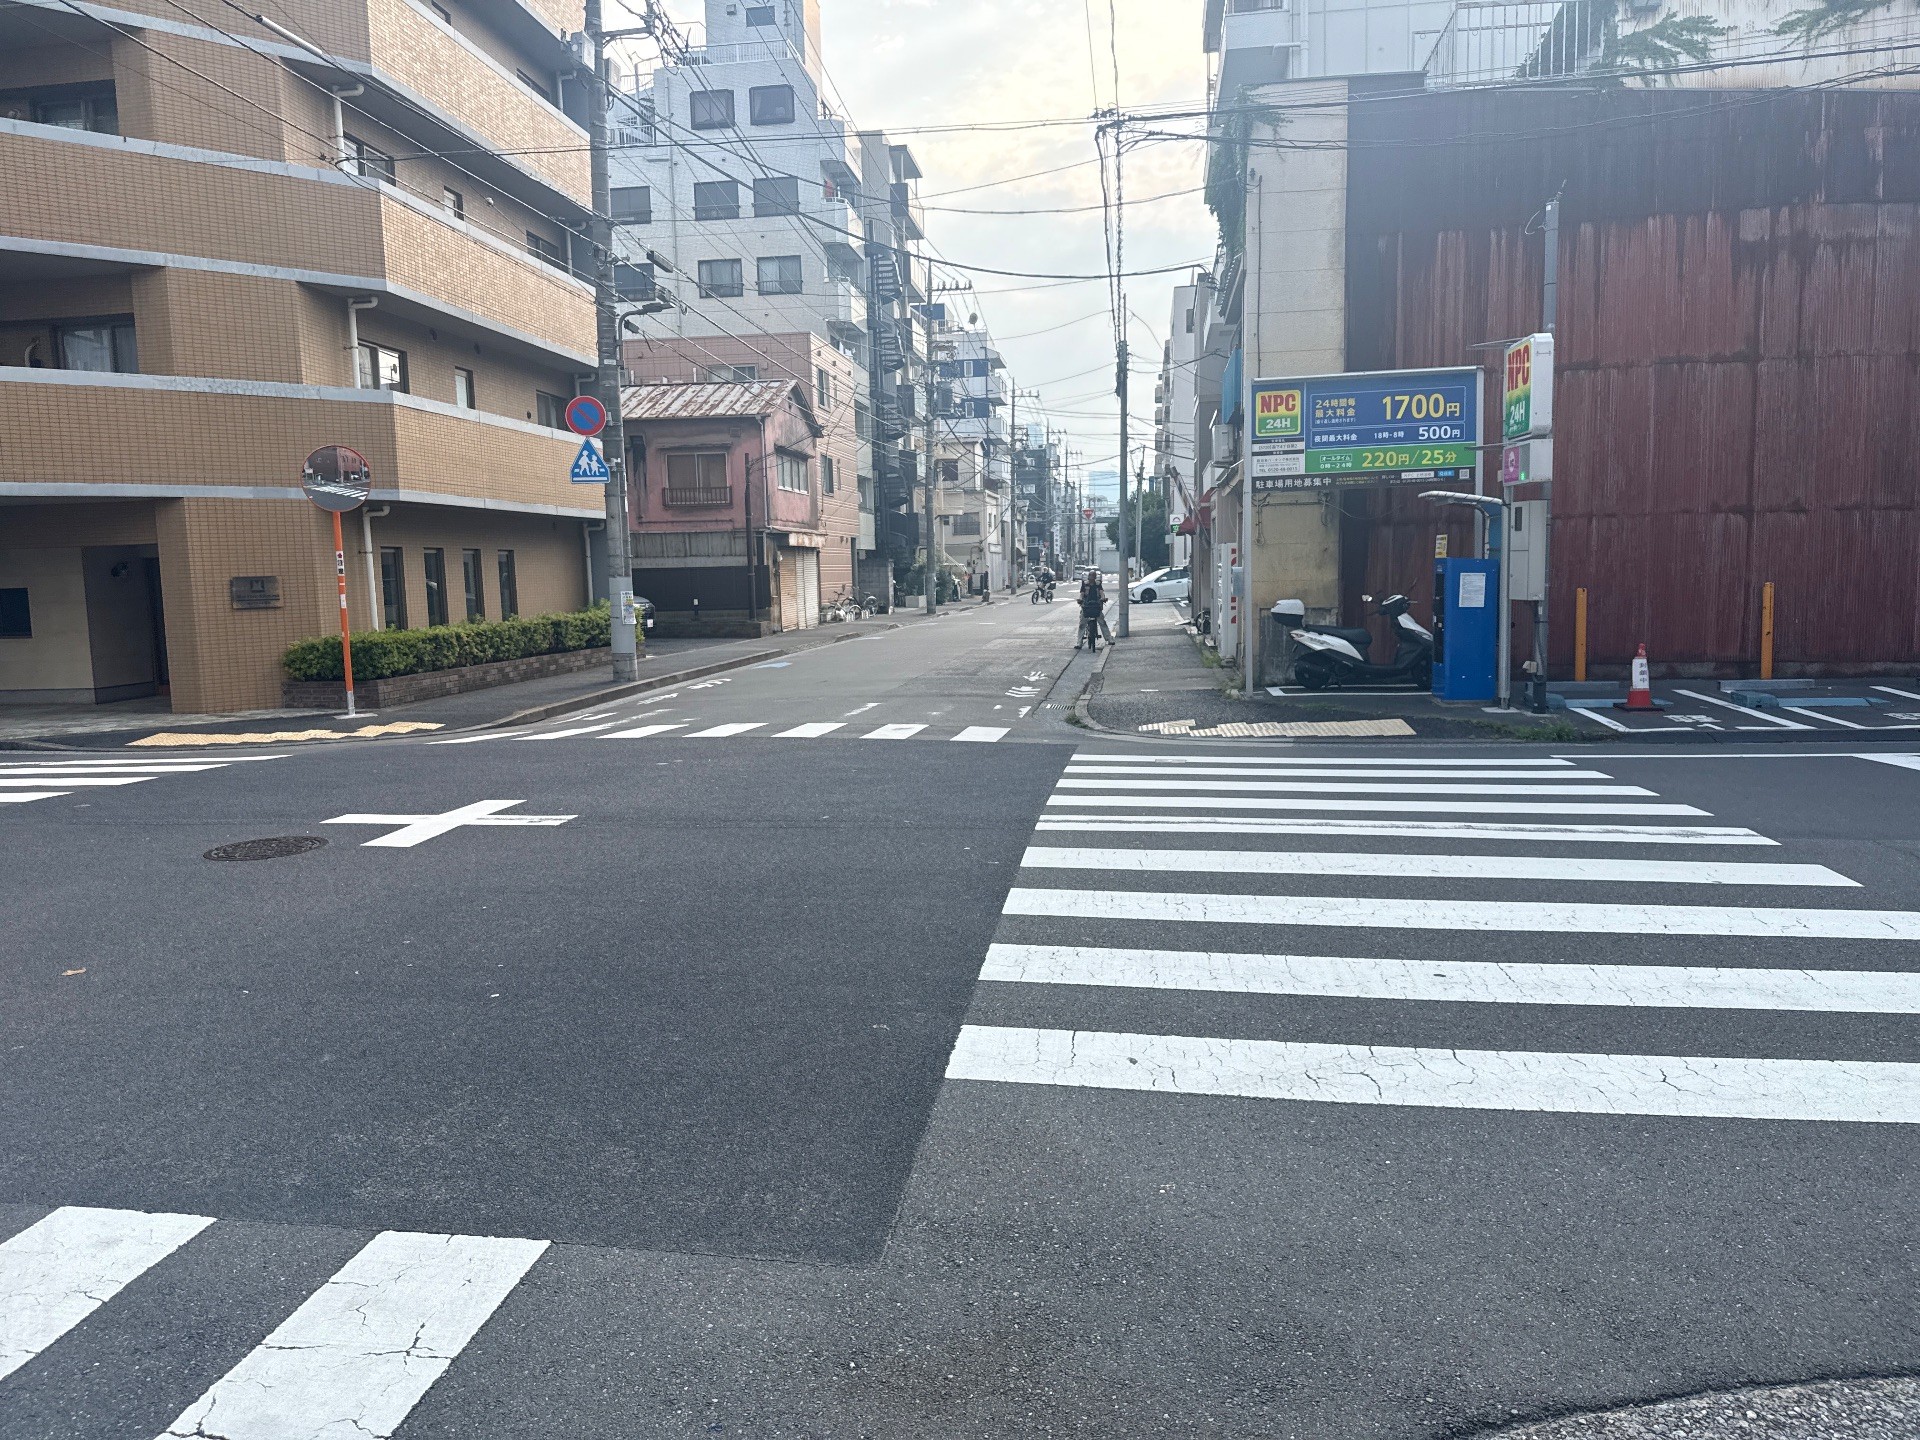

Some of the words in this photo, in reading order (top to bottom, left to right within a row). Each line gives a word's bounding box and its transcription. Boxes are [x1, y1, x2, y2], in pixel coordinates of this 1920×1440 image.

[1508, 344, 1530, 392] NPC
[1260, 394, 1296, 413] NPC
[1316, 398, 1356, 408] 24時間毎
[1382, 393, 1460, 420] 1700円
[1315, 408, 1356, 418] 最大料金
[1510, 401, 1525, 425] 24H
[1266, 418, 1290, 428] 24H
[1314, 433, 1358, 443] 夜間最大料金
[1418, 425, 1461, 440] 500円
[1256, 478, 1332, 489] 駐車場用地募集中
